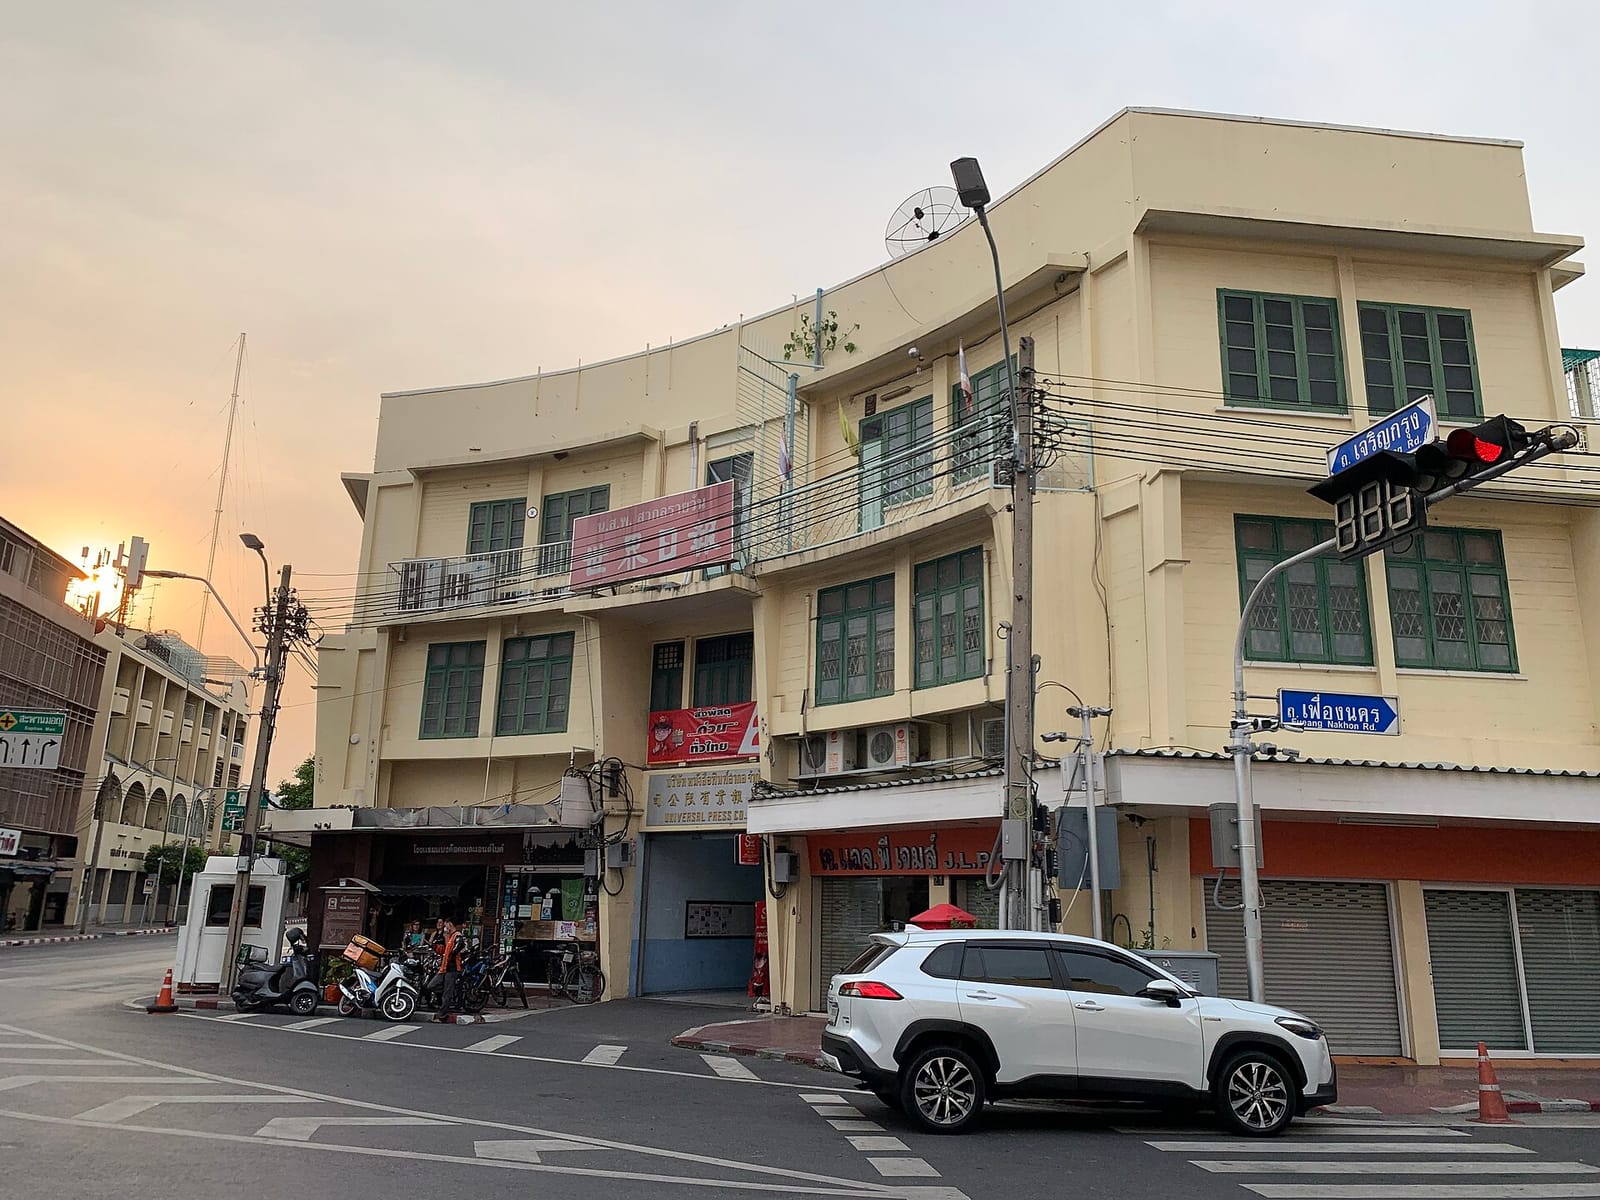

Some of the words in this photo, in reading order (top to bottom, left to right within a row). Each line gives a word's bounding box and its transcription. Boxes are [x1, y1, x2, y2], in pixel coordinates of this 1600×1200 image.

[1340, 454, 1351, 468] ถ.
[1354, 411, 1420, 460] เจริญกรุง
[1407, 435, 1422, 449] Rd.
[693, 707, 731, 718] ส่งพัสดุ
[1287, 706, 1299, 718] ถ.
[1302, 694, 1380, 723] เฟื่องนคร
[1327, 720, 1359, 730] Nakhon
[1362, 722, 1377, 731] Rd.
[689, 738, 728, 754] ทั่วไทย
[664, 811, 705, 823] UNIVERSAL
[707, 810, 733, 822] PRESS
